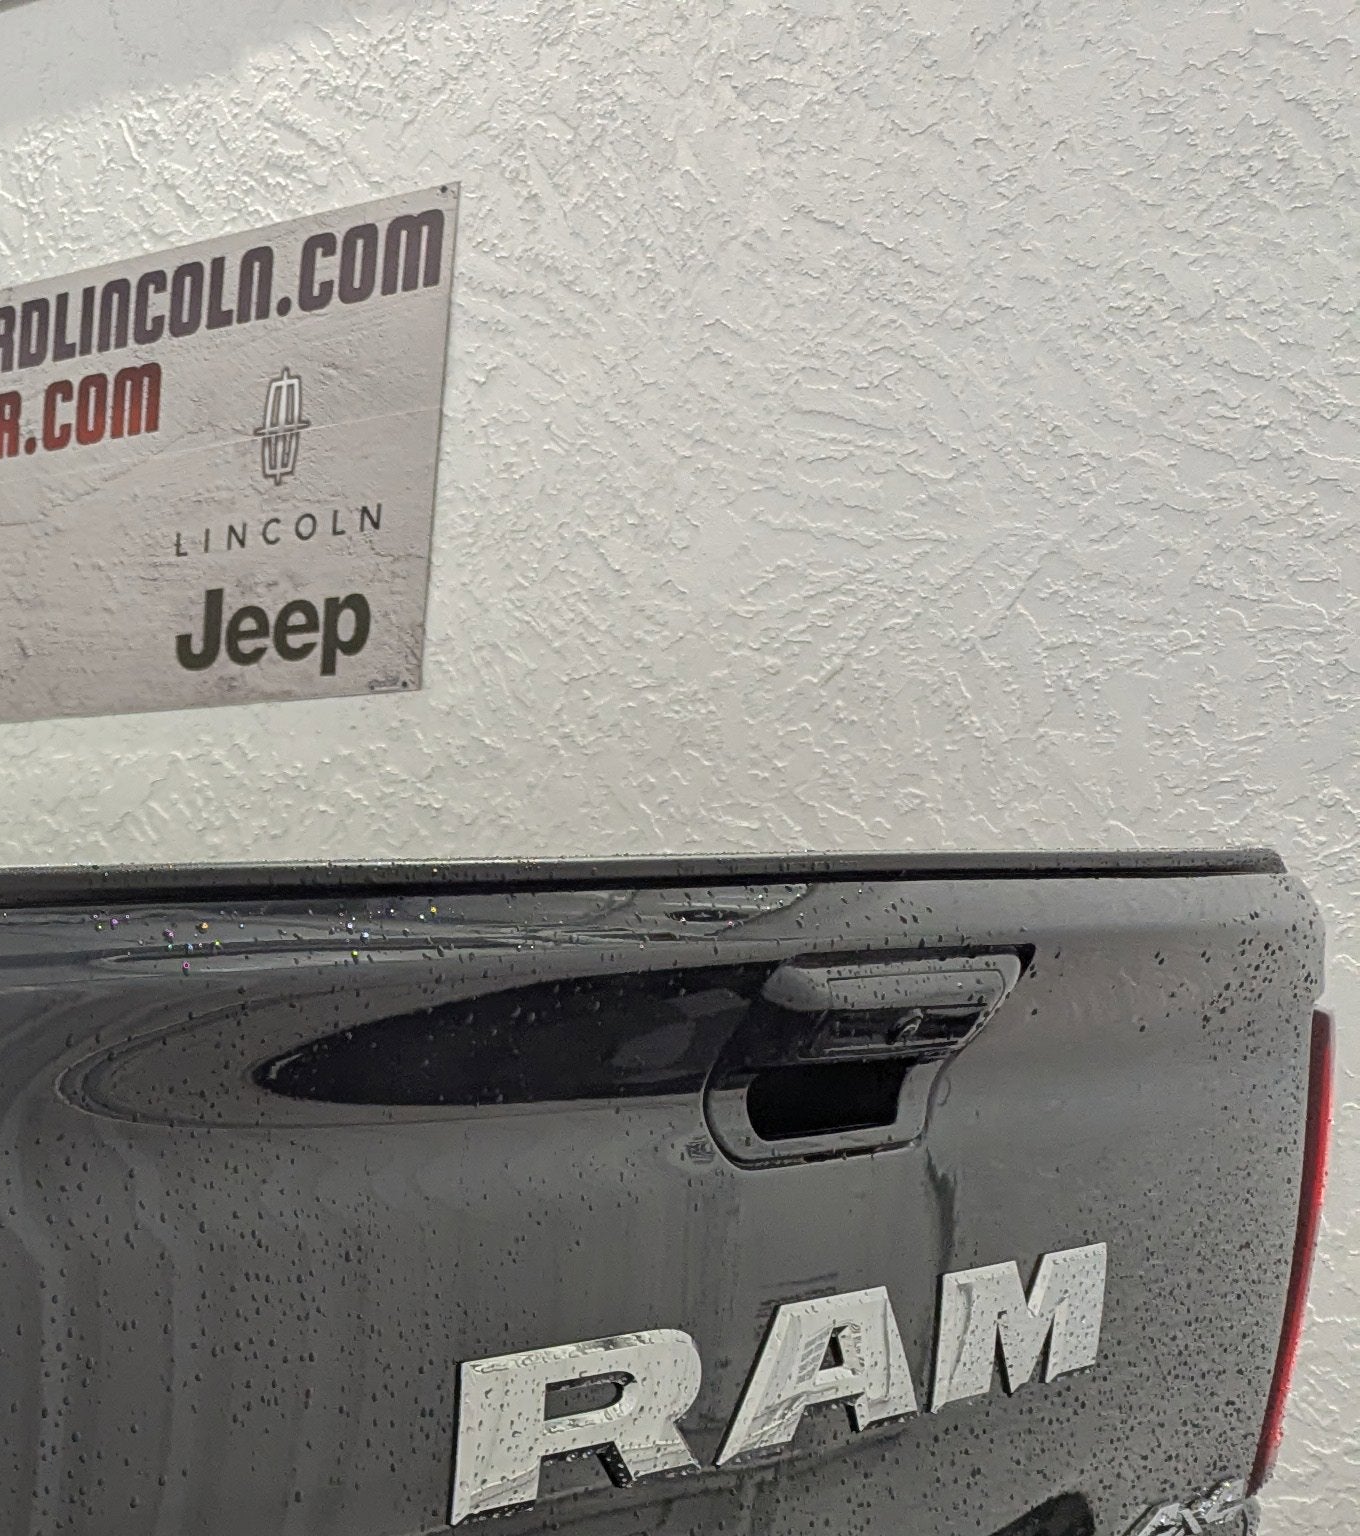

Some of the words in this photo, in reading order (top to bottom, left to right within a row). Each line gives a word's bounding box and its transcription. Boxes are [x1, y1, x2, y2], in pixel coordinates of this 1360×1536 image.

[175, 502, 382, 557] LINCOLN
[175, 587, 371, 677] Jeep
[449, 1241, 1107, 1527] RAM
